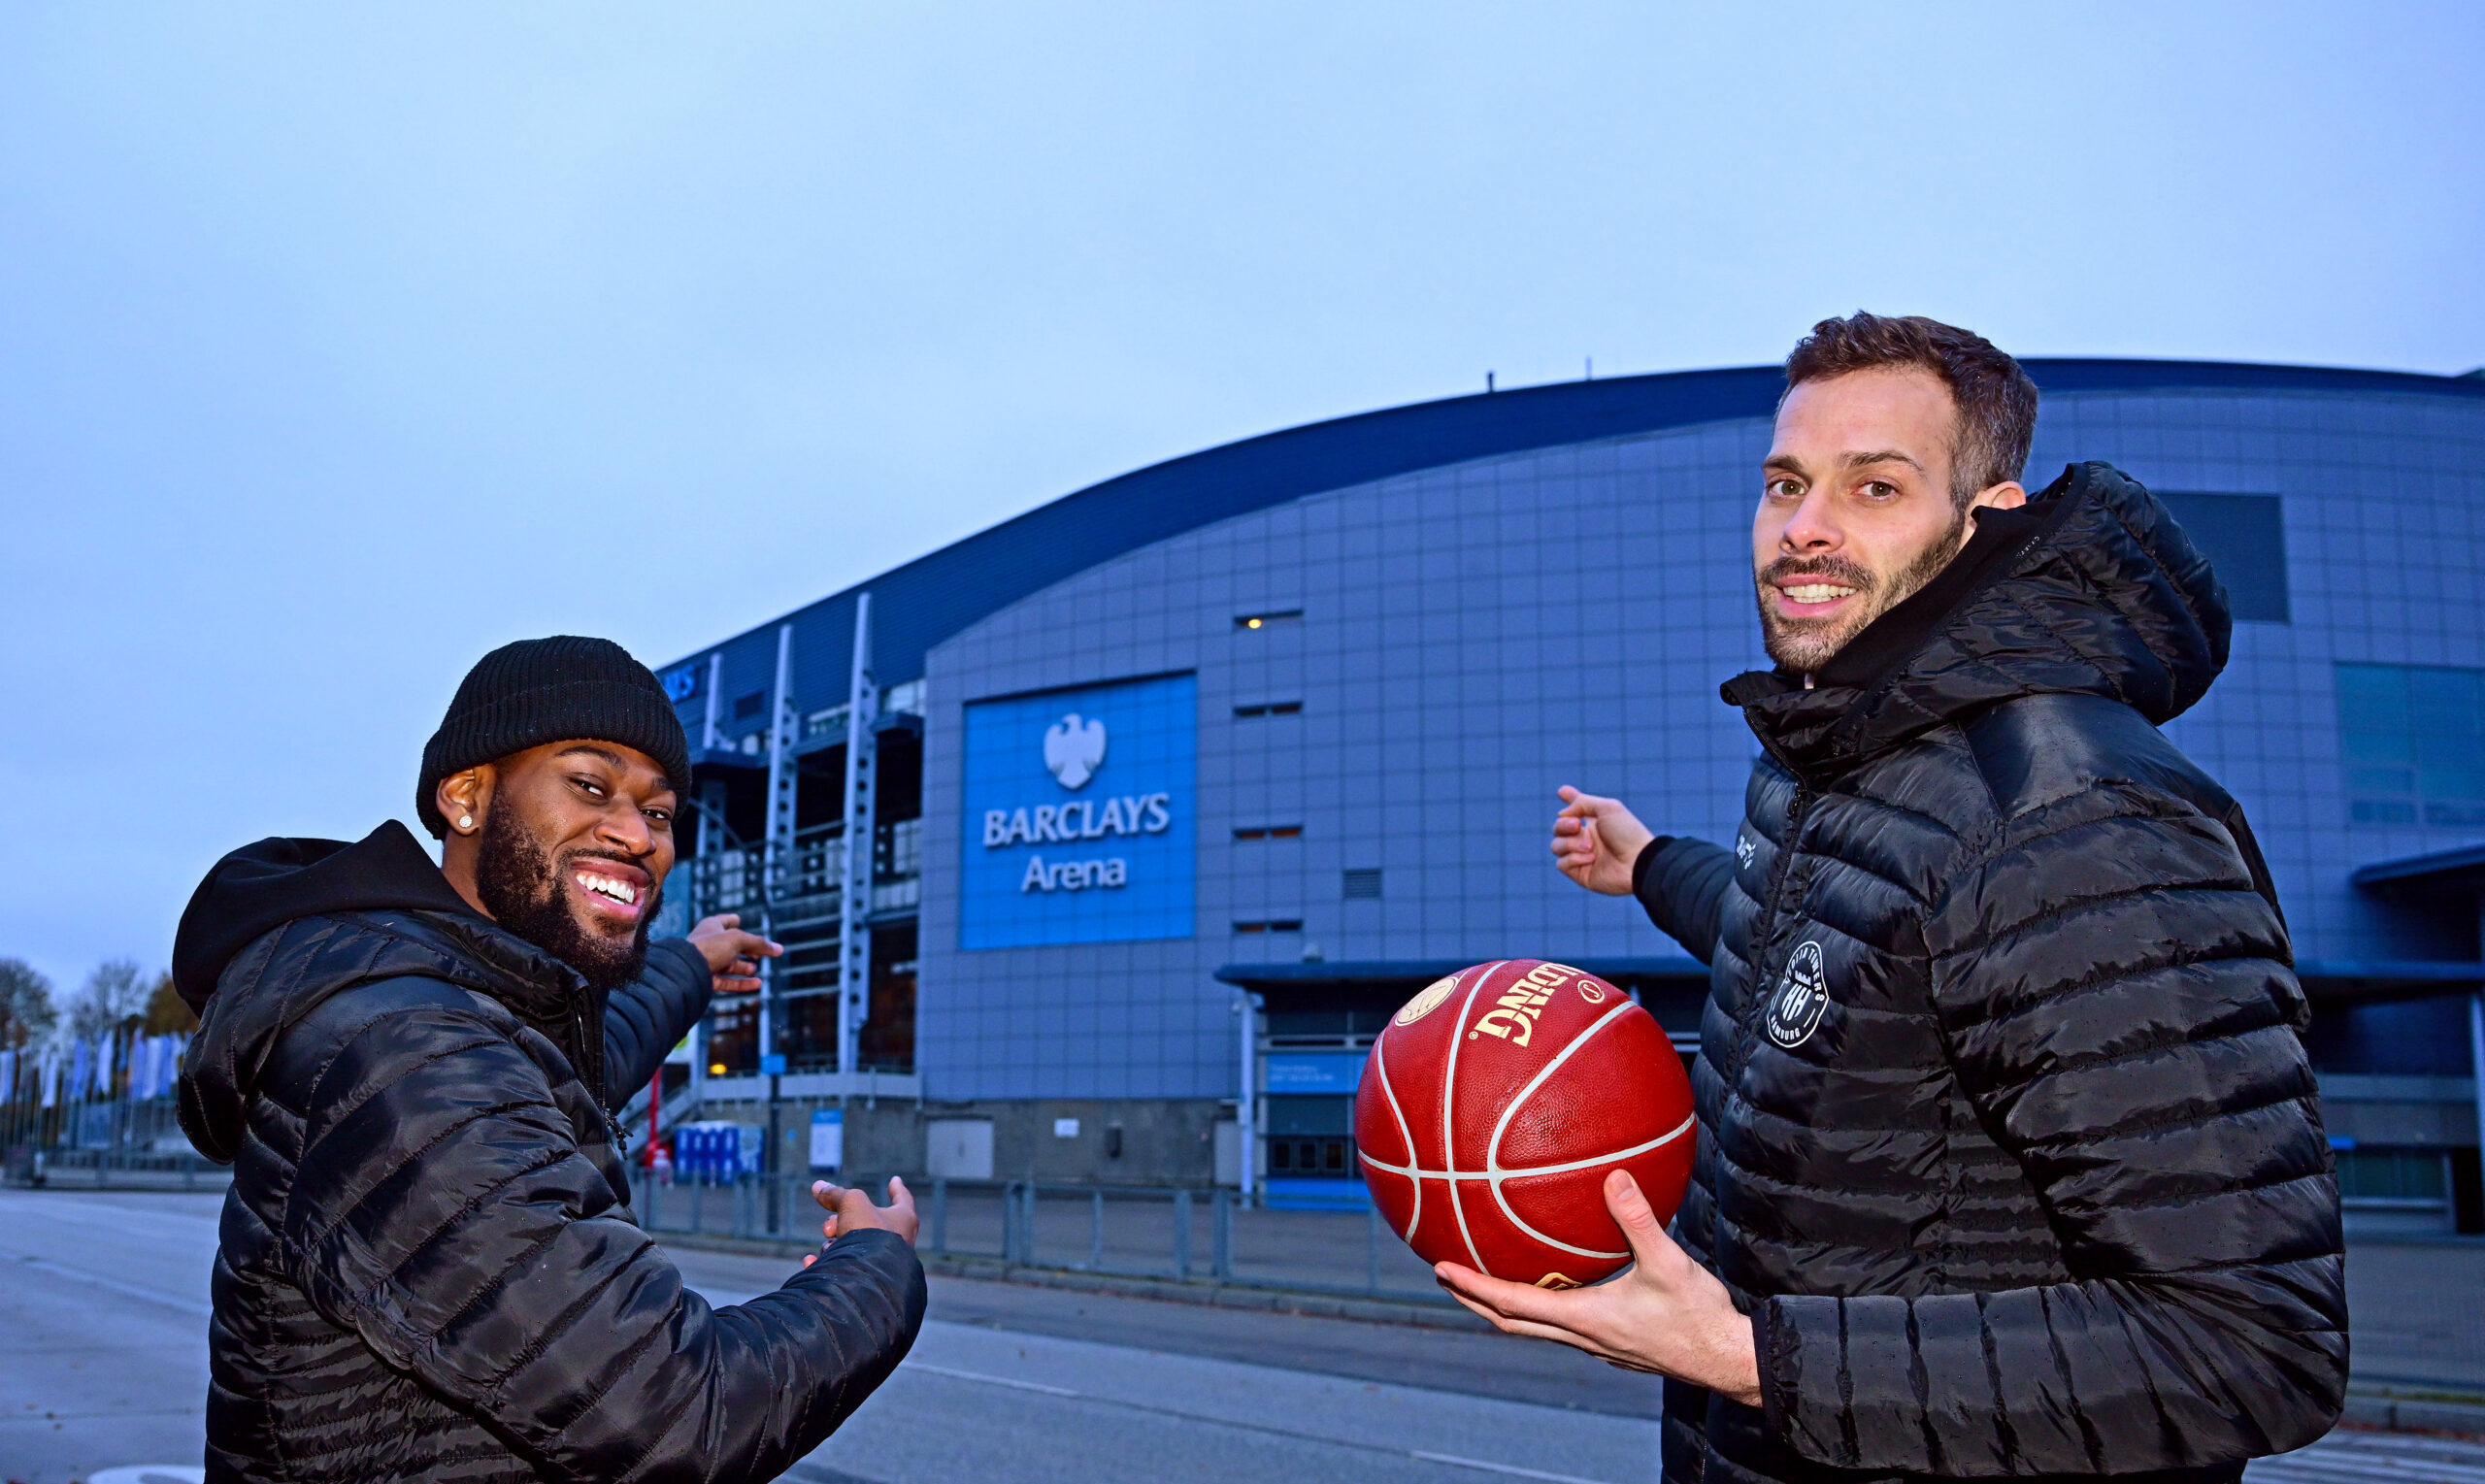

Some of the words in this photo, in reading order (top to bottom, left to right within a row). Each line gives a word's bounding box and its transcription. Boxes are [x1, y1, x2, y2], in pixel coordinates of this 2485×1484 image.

[983, 792, 1171, 846] BARCLAYS
[1020, 854, 1127, 892] Arena
[1808, 948, 1826, 1002] TOWERS
[1771, 1014, 1801, 1040] HAMBURG
